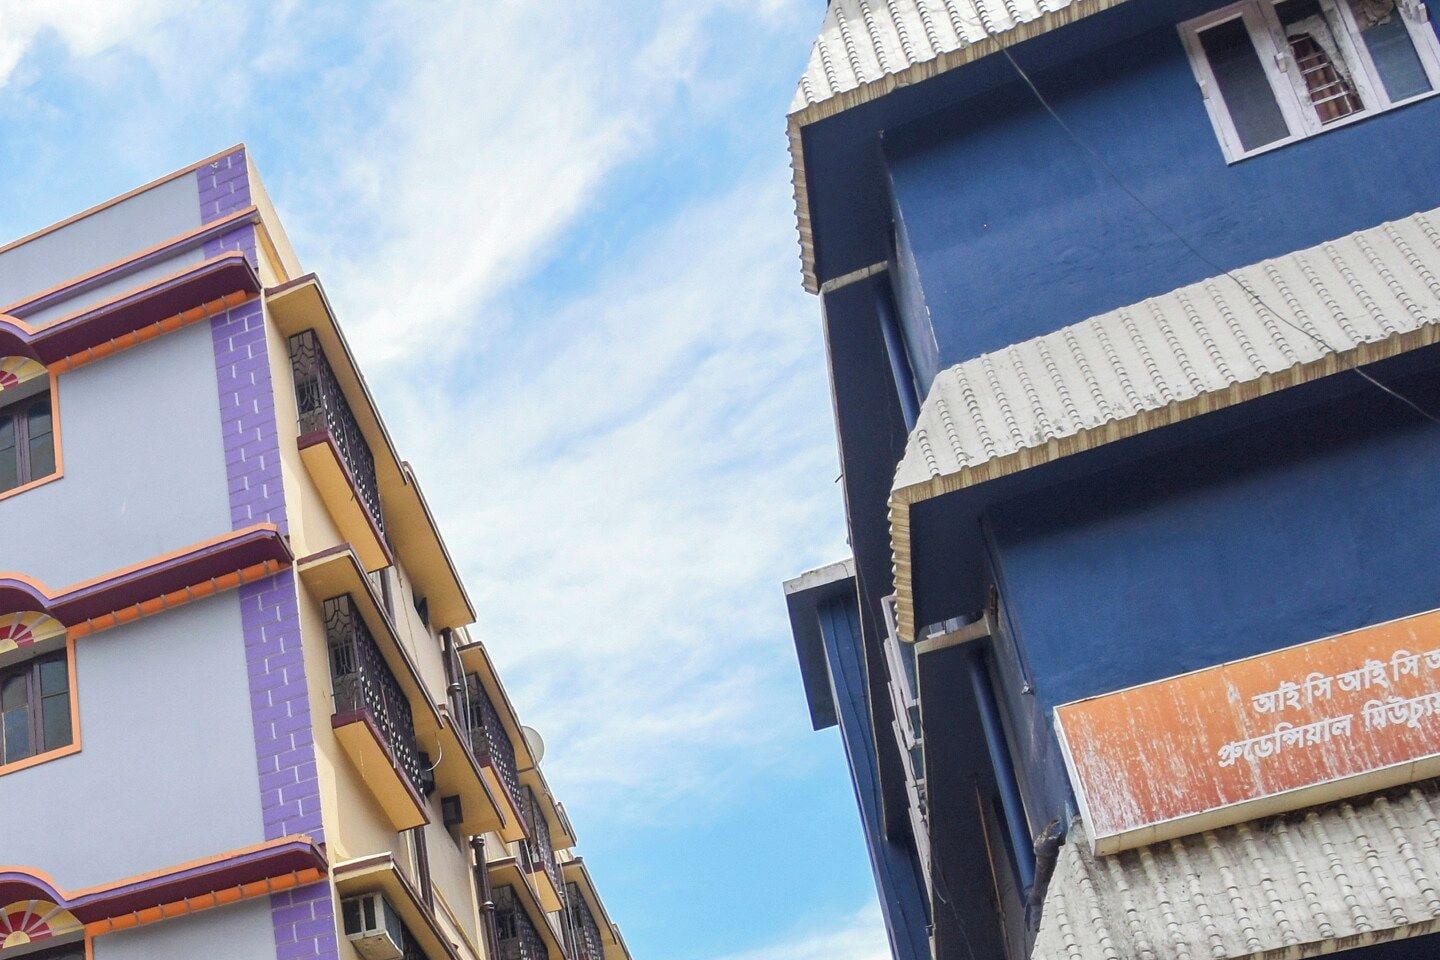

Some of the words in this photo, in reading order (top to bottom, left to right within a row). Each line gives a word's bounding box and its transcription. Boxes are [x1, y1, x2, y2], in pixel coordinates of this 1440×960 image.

[1252, 681, 1302, 713] আই
[1304, 672, 1334, 704] সি
[1336, 659, 1389, 691] আই
[1390, 649, 1421, 681] সি
